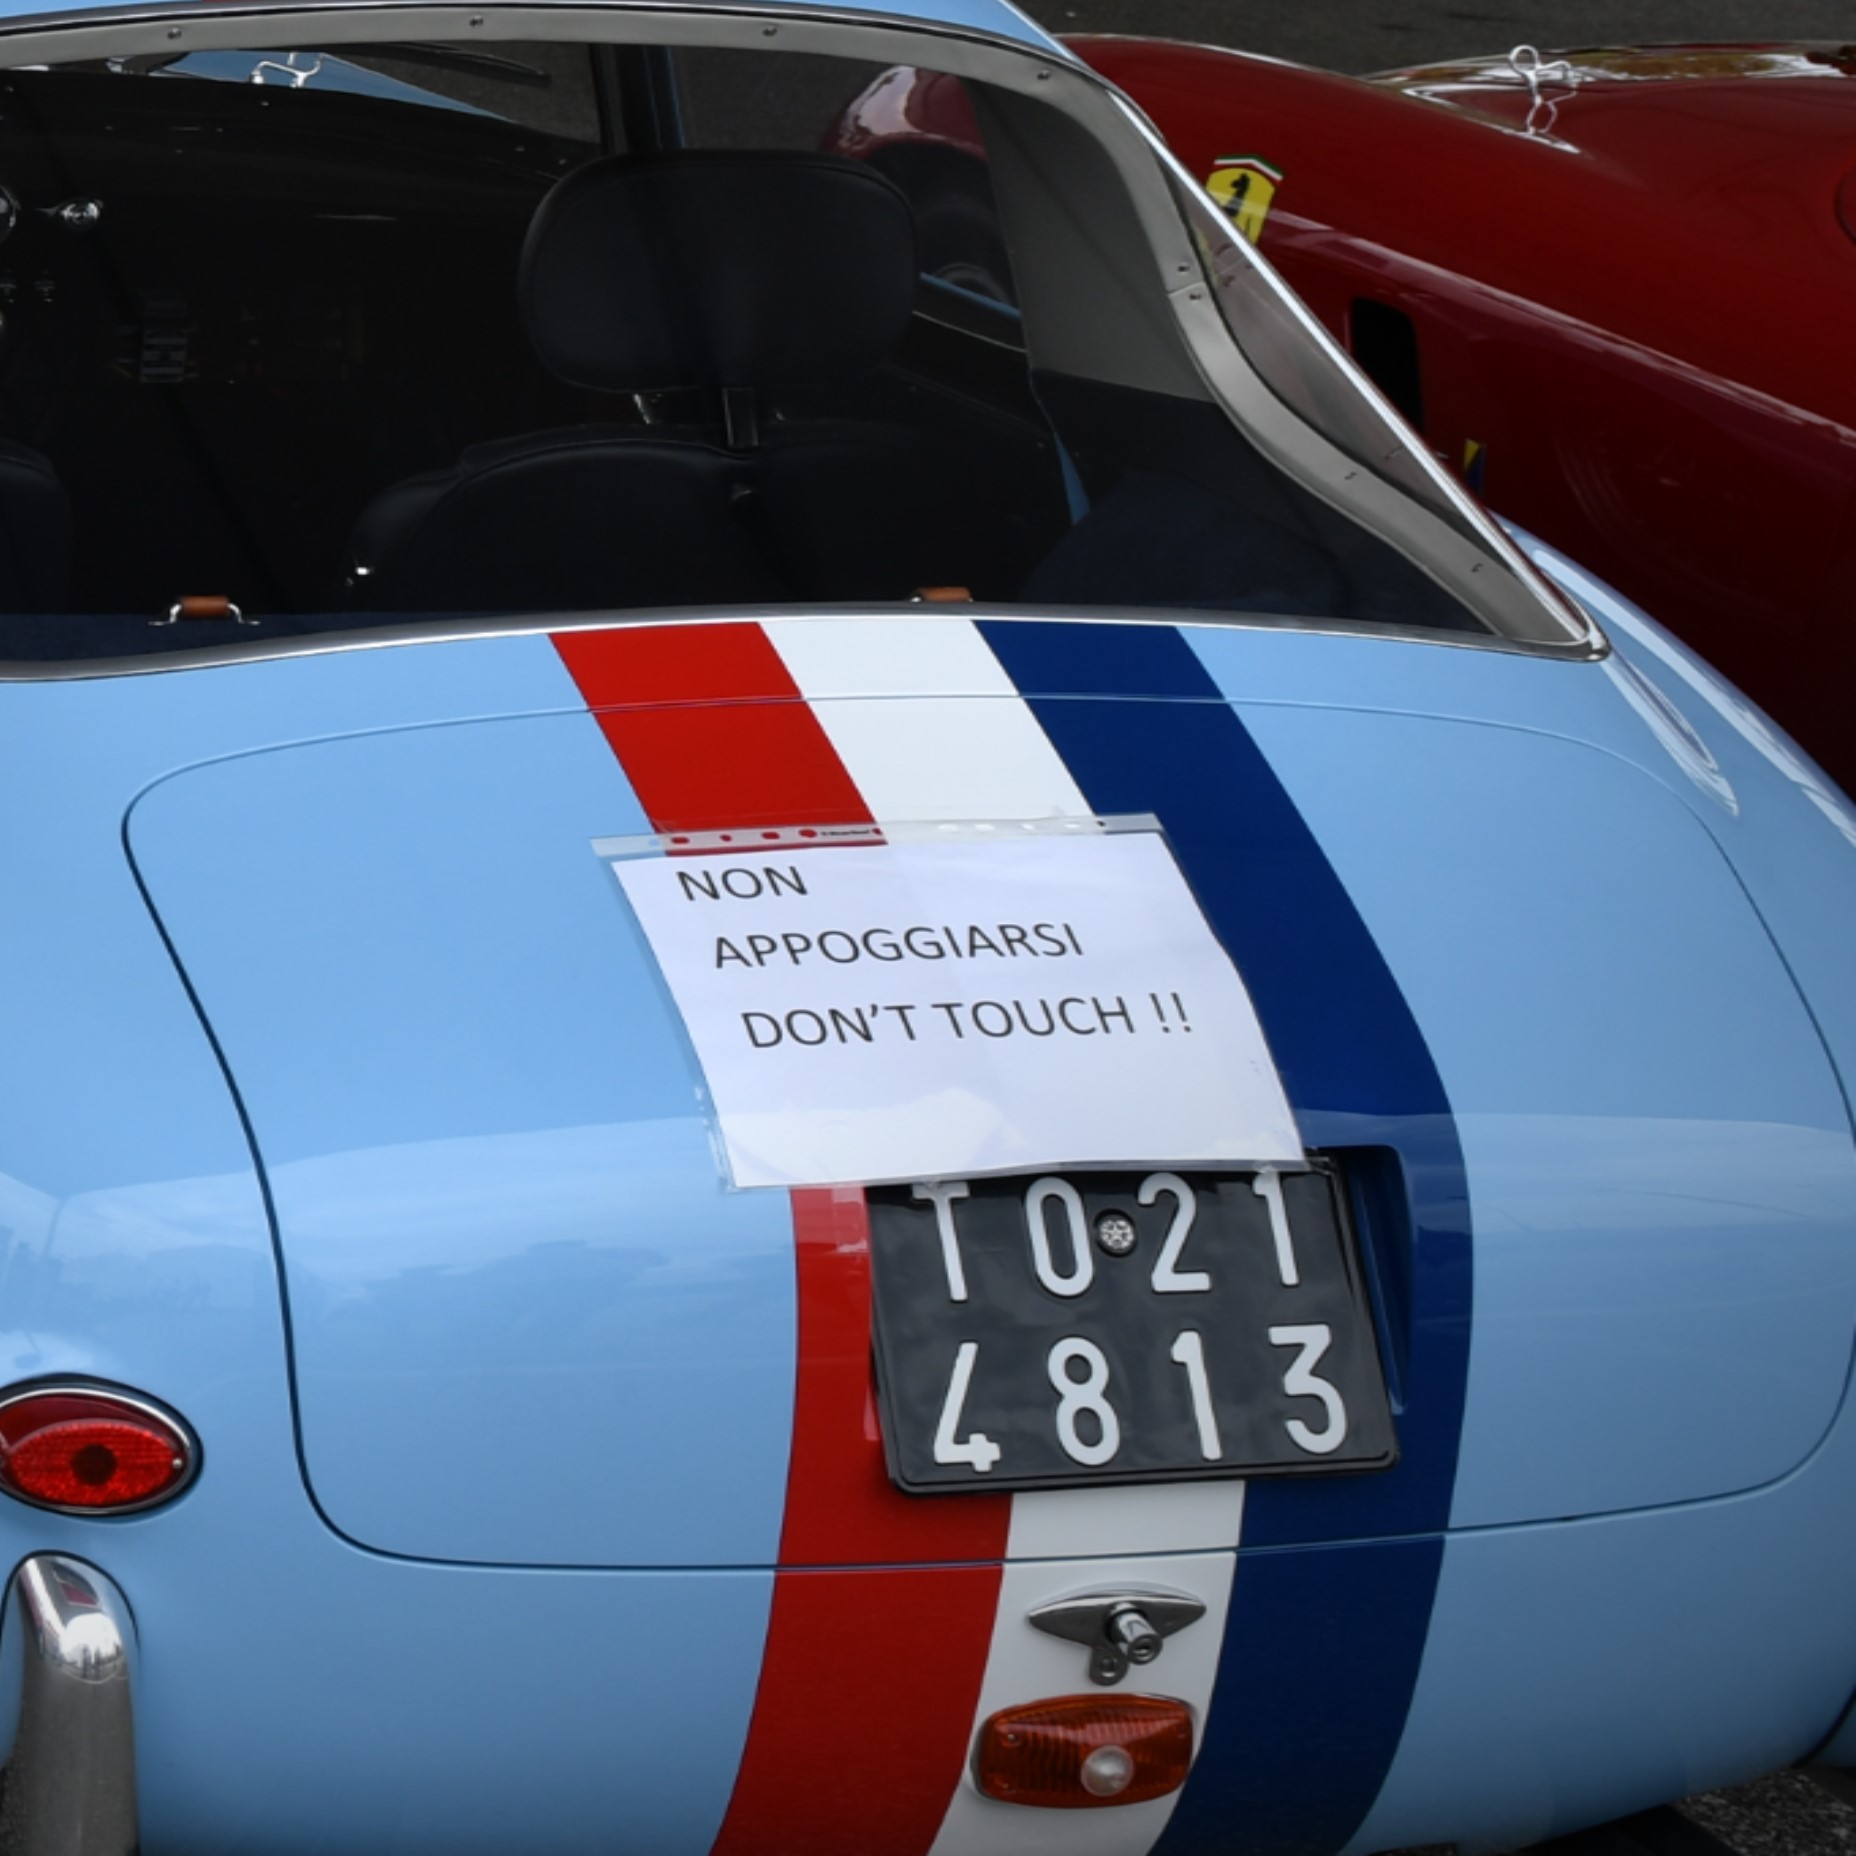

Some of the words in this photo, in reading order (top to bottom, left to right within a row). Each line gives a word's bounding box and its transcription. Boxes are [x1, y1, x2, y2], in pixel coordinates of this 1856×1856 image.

[675, 864, 809, 902] NON
[713, 922, 1085, 969] APPOGGIARSI
[741, 1003, 917, 1049] DON'T
[932, 995, 1136, 1039] TOUCH
[933, 1324, 1348, 1472] 4813
